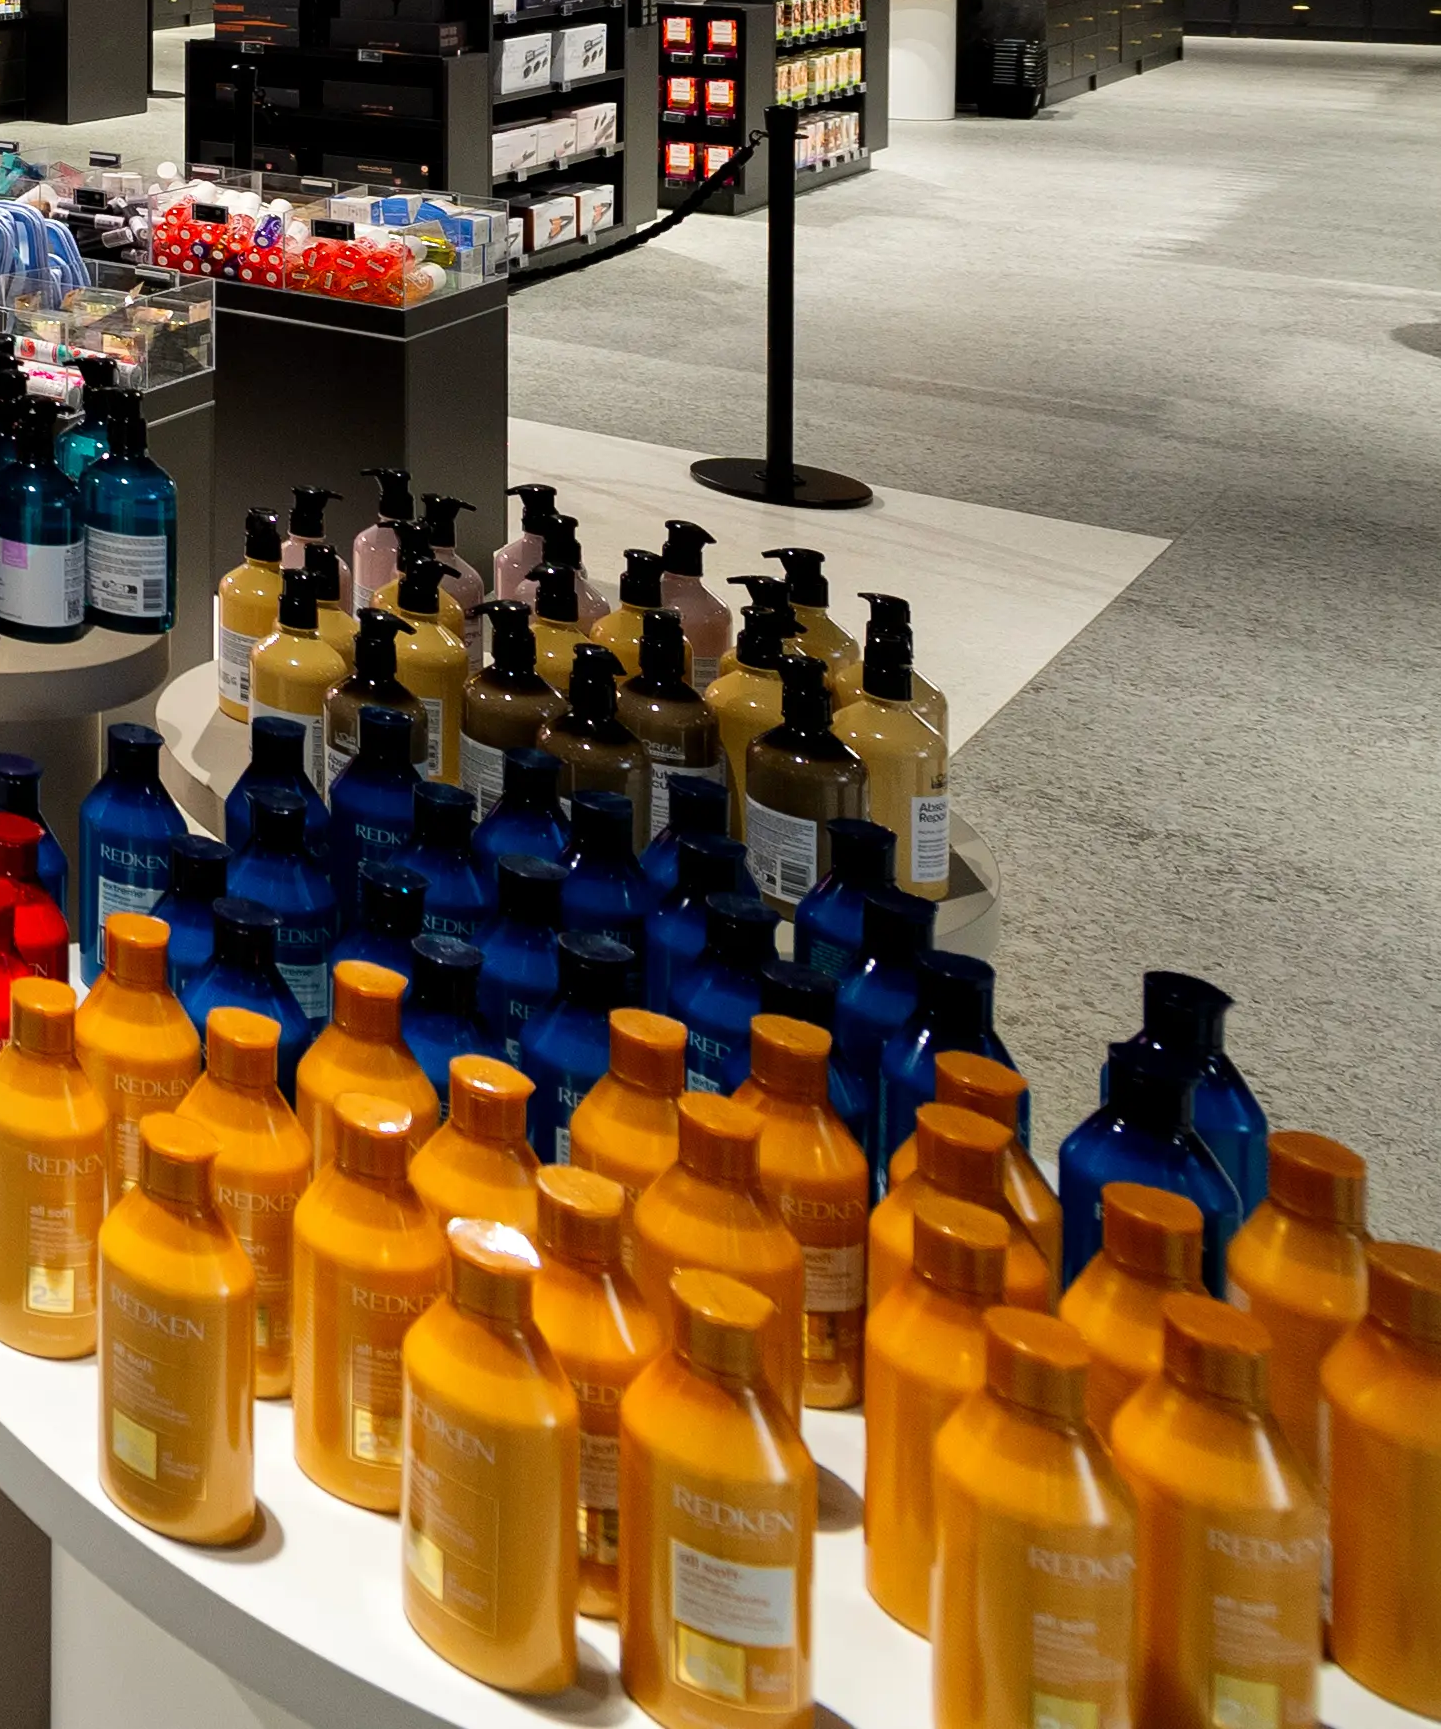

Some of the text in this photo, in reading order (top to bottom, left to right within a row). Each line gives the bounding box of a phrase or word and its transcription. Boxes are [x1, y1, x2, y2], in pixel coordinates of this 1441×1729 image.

[100, 842, 168, 870] REDKEN
[26, 1152, 104, 1177] REDKEN
[110, 1284, 205, 1341] REDKEN
[671, 1483, 795, 1534] REDKEN
